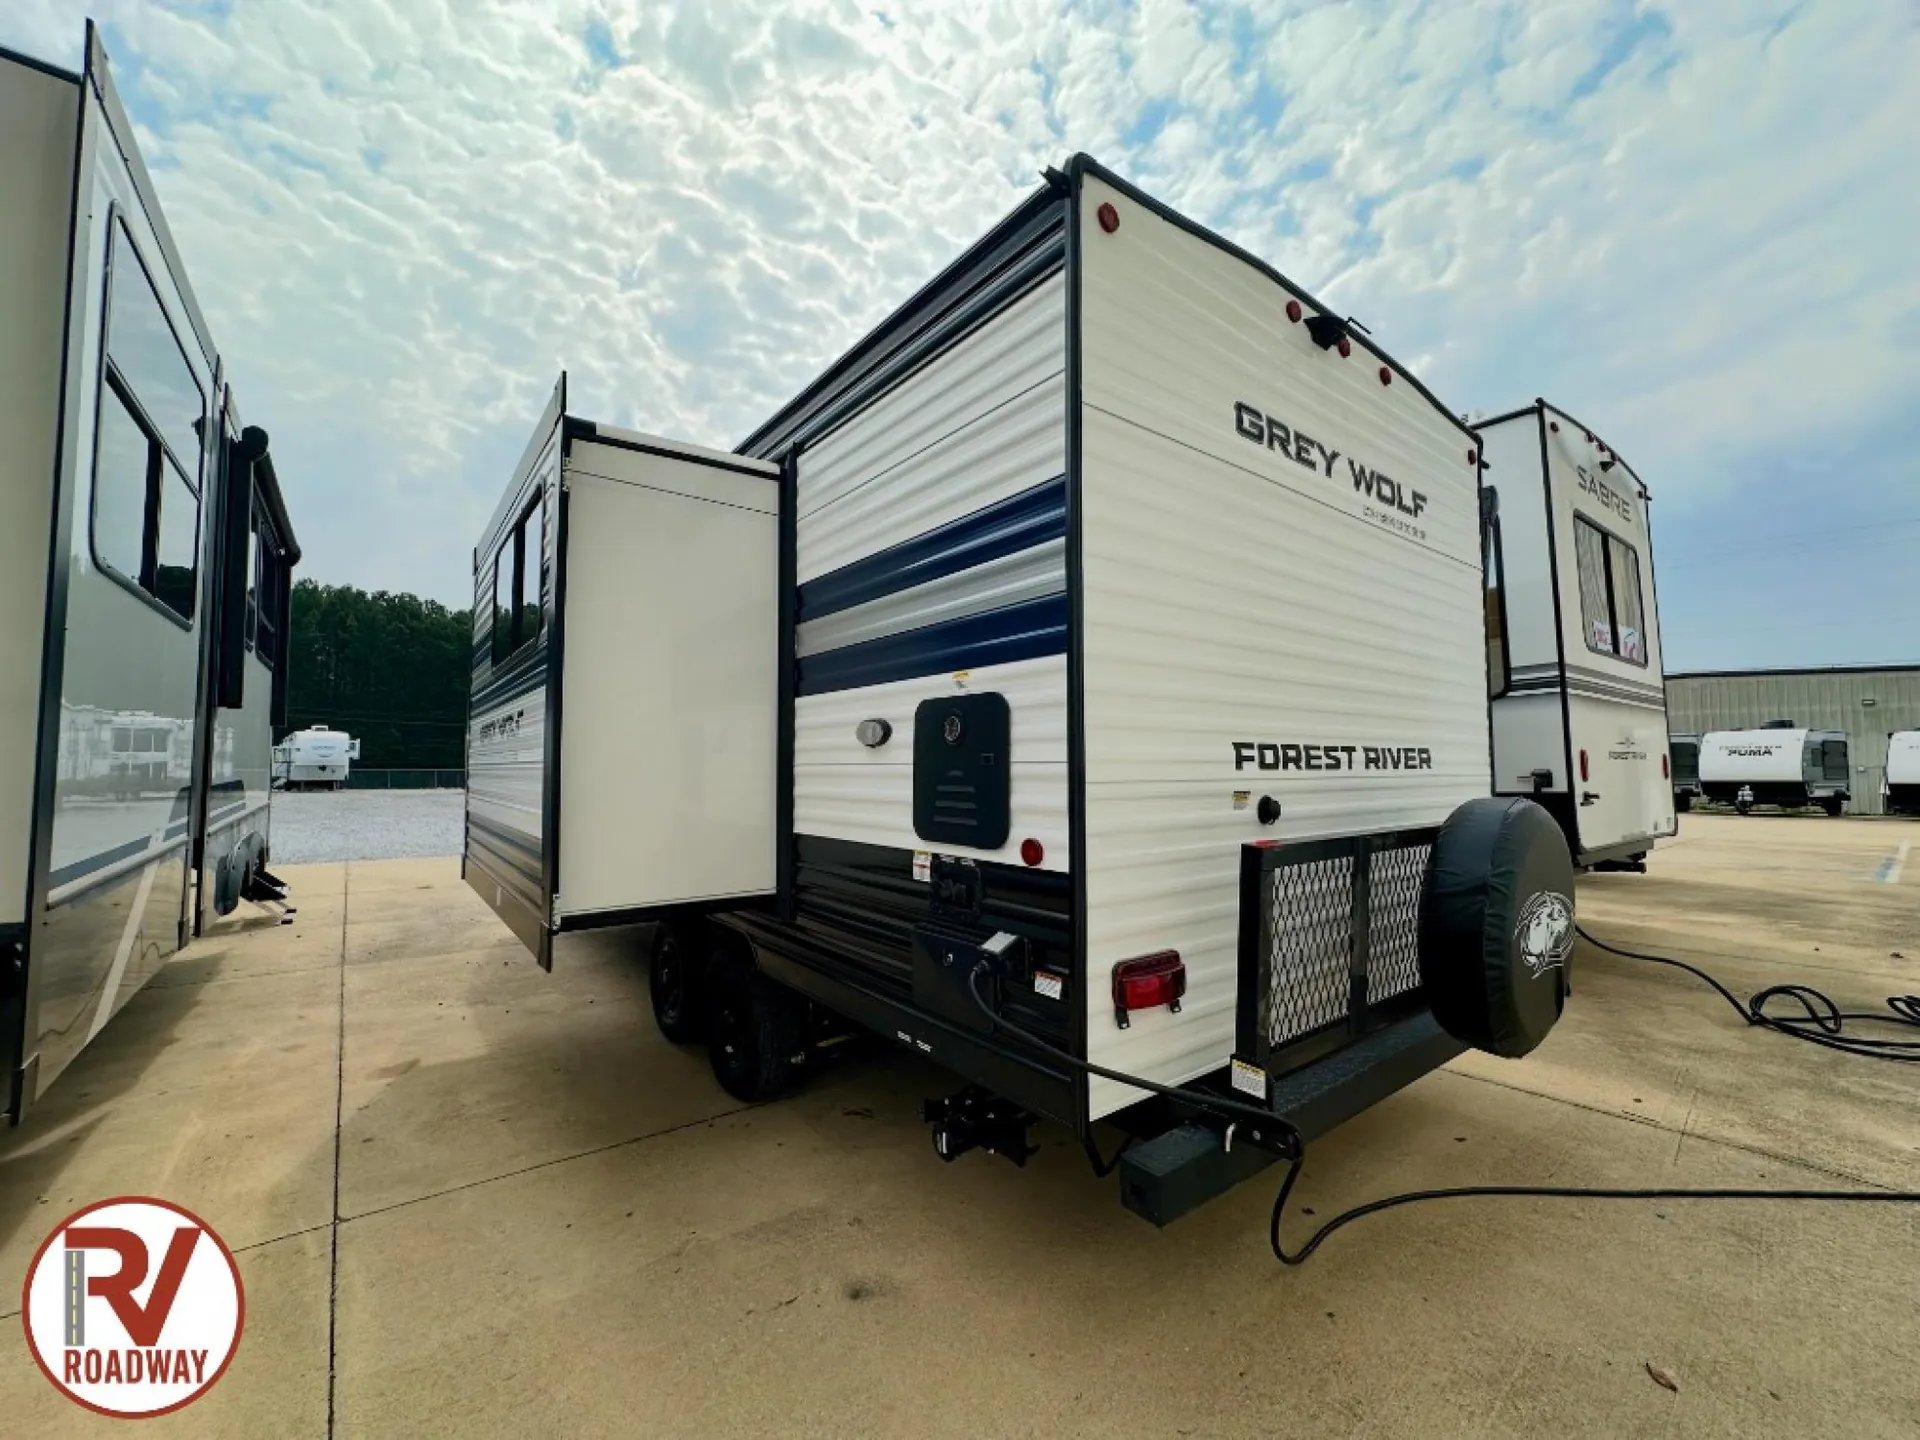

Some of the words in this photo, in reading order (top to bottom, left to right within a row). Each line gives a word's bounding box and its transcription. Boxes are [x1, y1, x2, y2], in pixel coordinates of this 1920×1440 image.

[1234, 400, 1341, 479] GREY
[1347, 456, 1428, 518] WOLF
[1577, 464, 1633, 524] SABRE
[1231, 741, 1357, 772] FOREST
[1361, 745, 1433, 771] RIVER
[1728, 749, 1773, 757] PUMA
